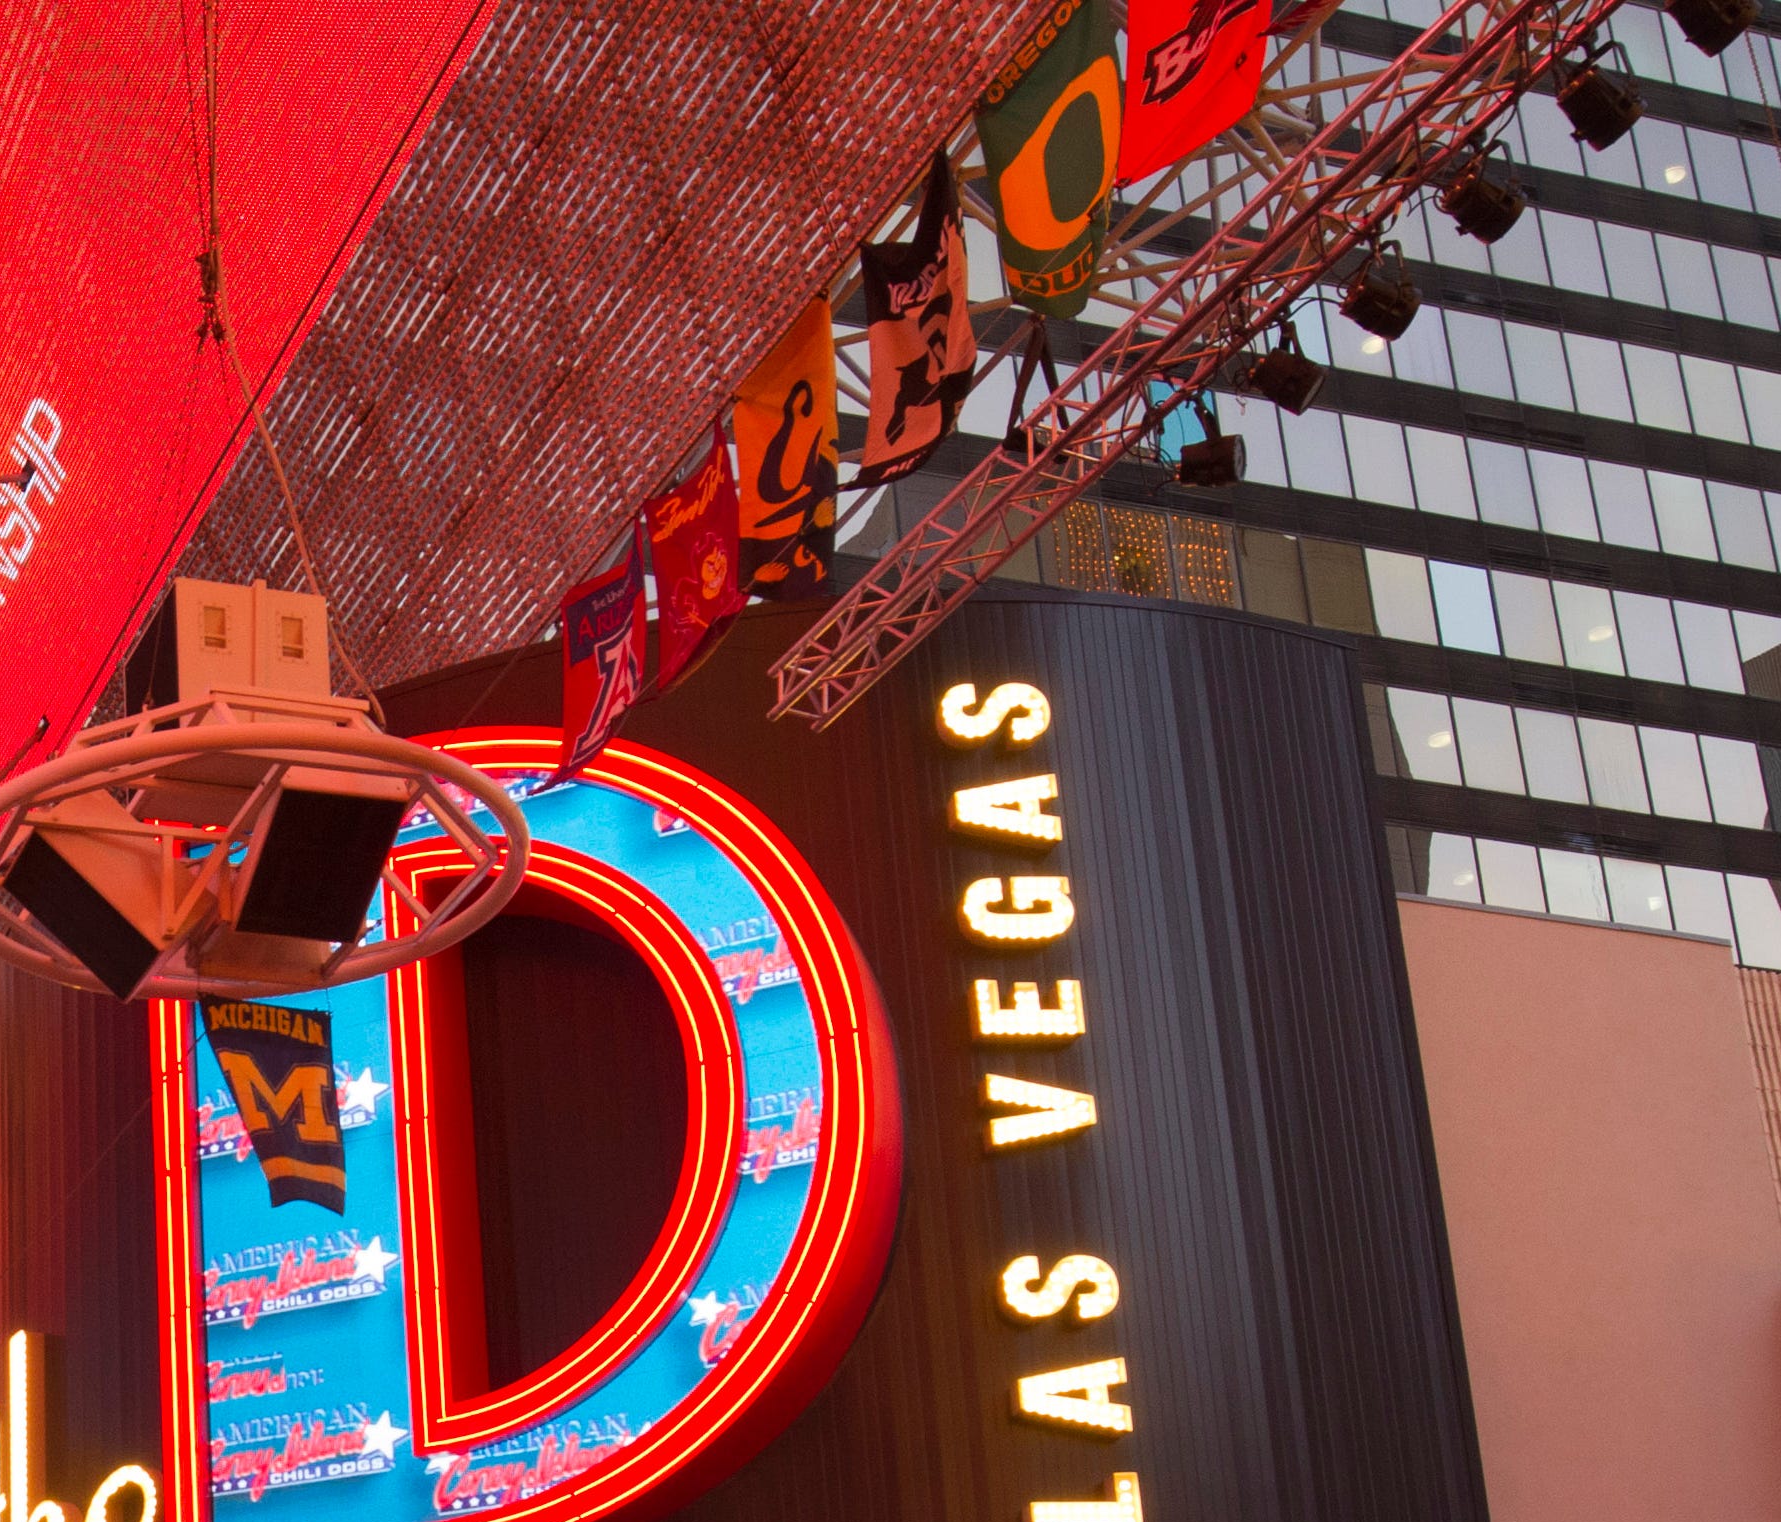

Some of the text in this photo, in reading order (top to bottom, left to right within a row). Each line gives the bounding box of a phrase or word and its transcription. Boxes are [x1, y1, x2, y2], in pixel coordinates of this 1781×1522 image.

[936, 680, 1100, 1158] VEGAS
[208, 1003, 327, 1047] MICHIGAN
[219, 1050, 340, 1143] M
[208, 1228, 360, 1274] AMERICAN
[262, 1281, 377, 1312] CHILI DOGS
[212, 1401, 369, 1447] AMERICAN
[269, 1455, 386, 1485] CHILI DOGS
